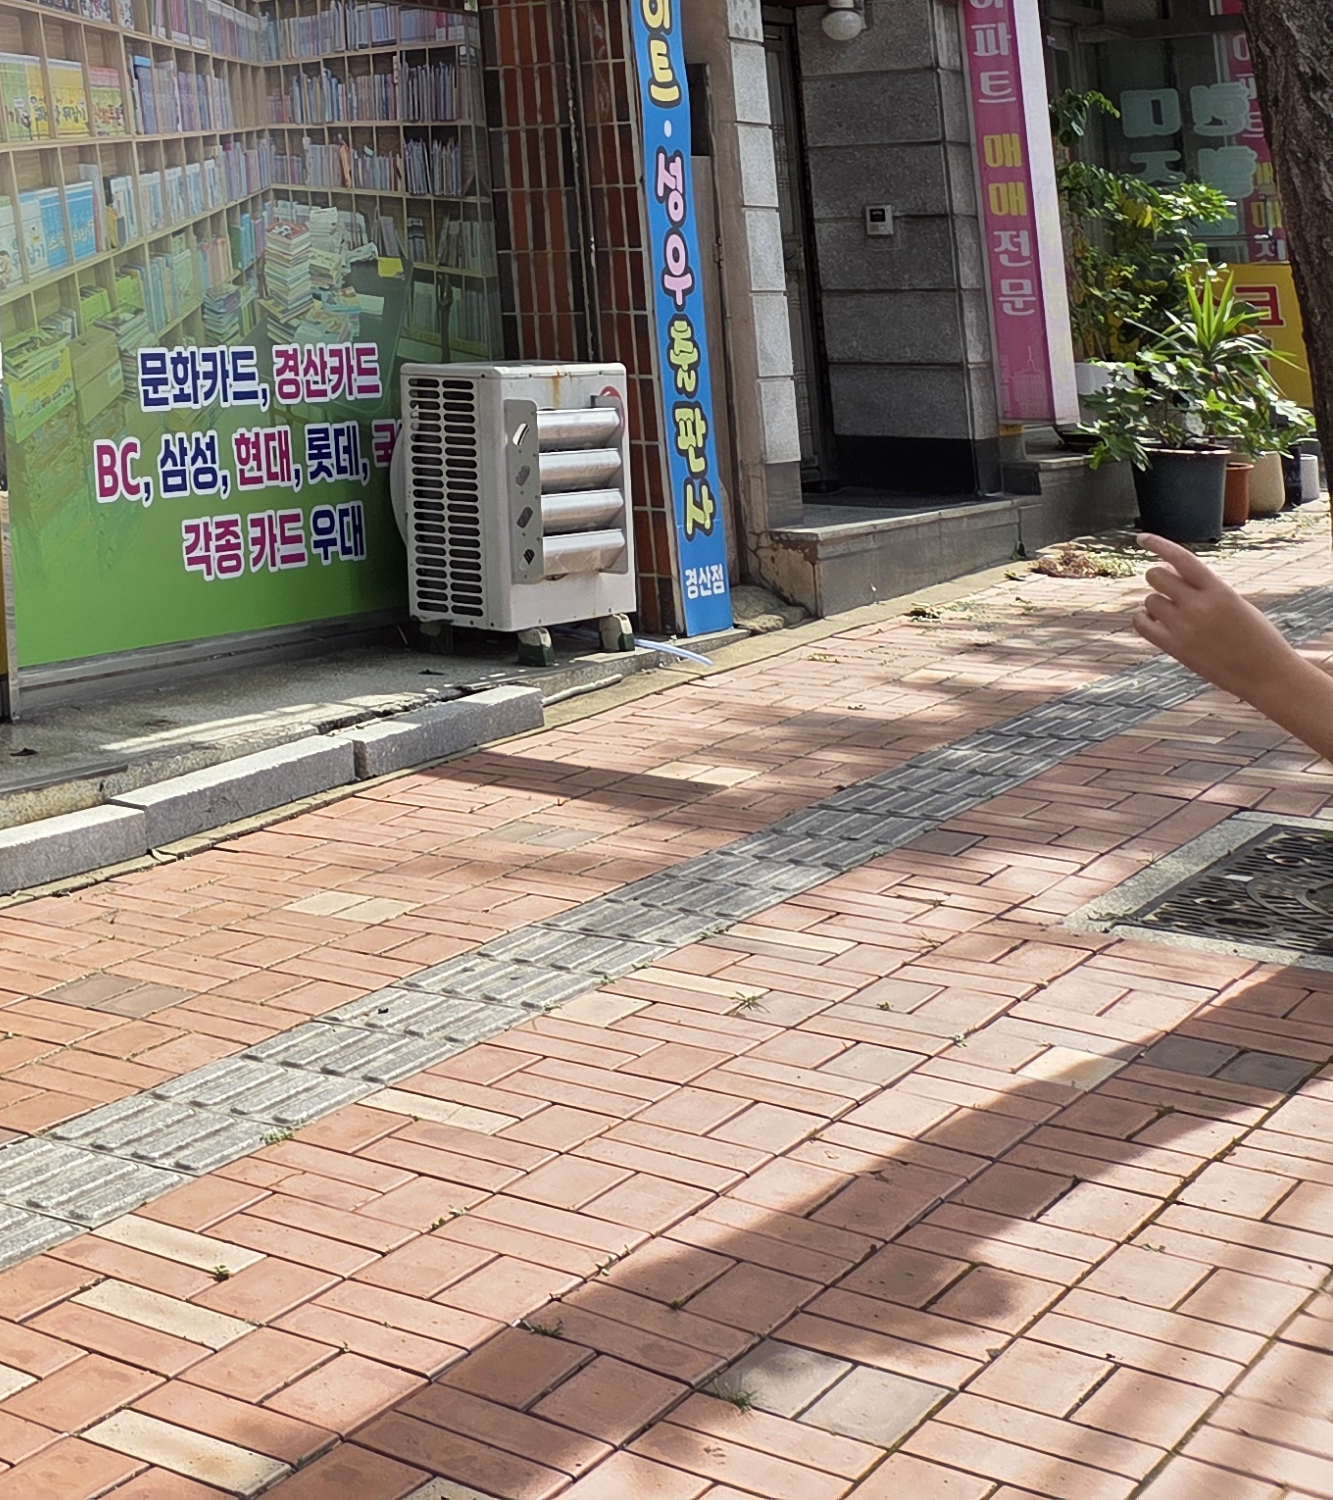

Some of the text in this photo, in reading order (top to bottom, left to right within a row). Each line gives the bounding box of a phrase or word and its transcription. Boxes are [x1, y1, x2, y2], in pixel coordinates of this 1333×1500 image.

[139, 344, 381, 411] 문화카드, 경산카드
[96, 441, 151, 502] BC,
[160, 434, 230, 496] 삼성,
[235, 426, 302, 490] 현대,
[307, 422, 370, 484] 롯데,
[183, 504, 366, 578] 각종 카드 우대
[684, 564, 724, 600] 경산점
